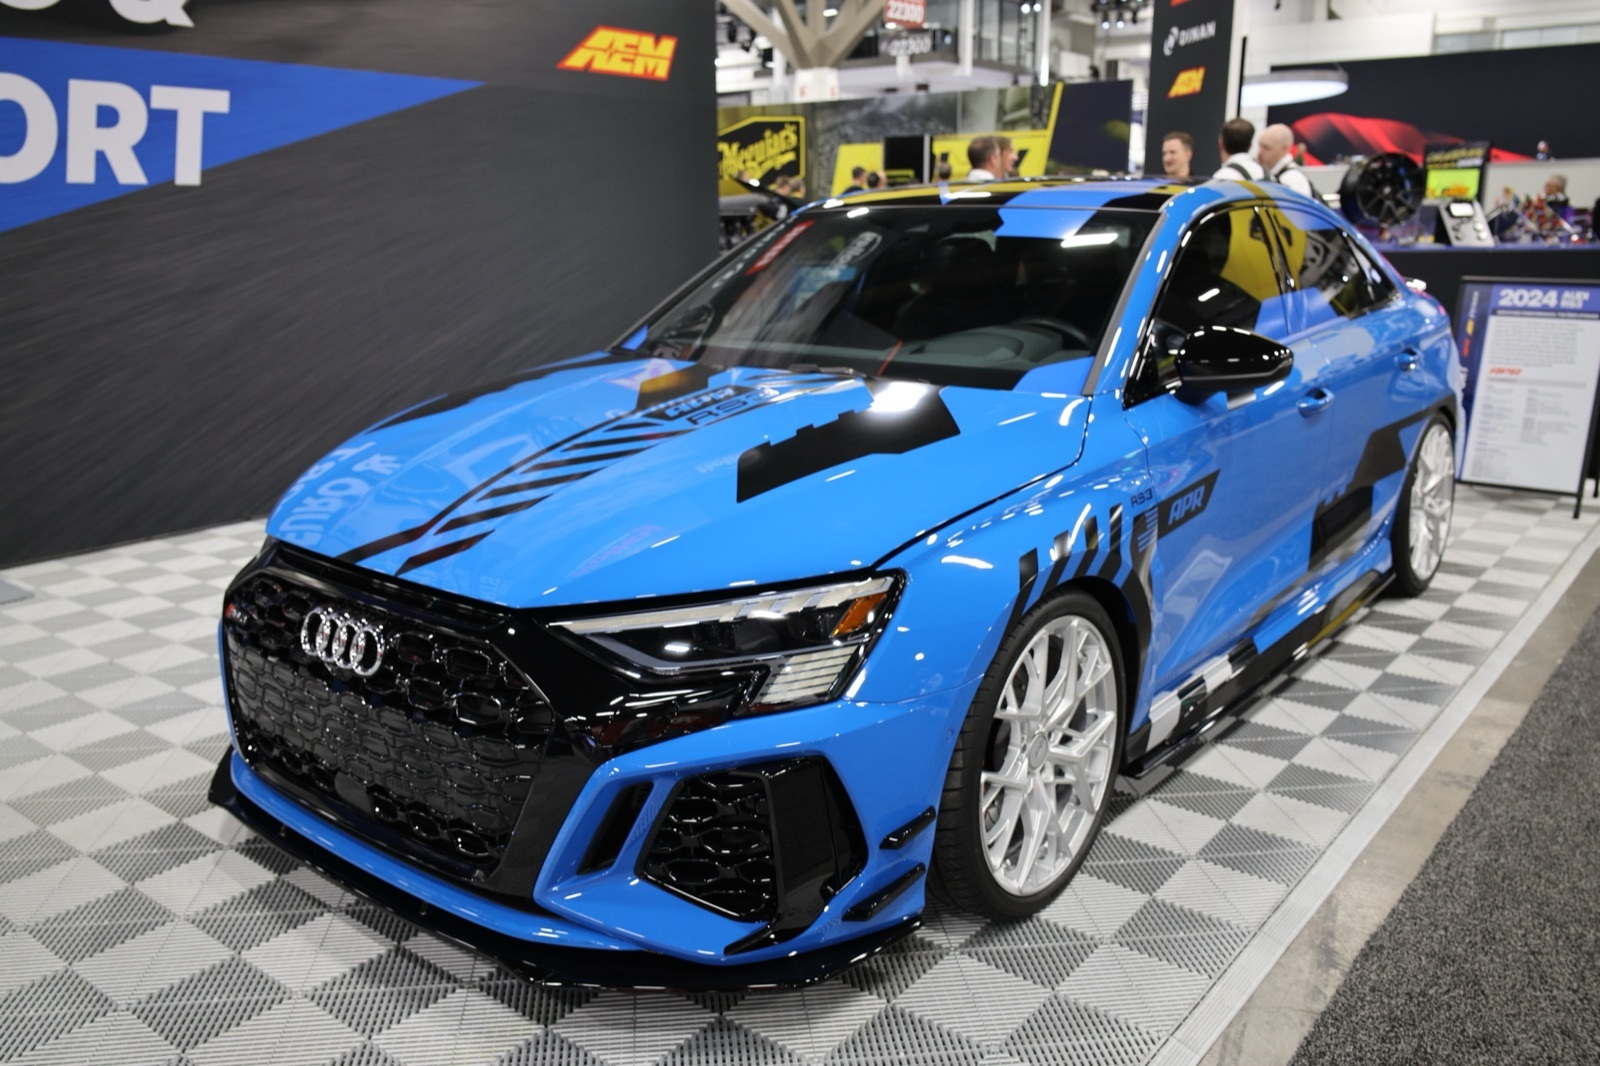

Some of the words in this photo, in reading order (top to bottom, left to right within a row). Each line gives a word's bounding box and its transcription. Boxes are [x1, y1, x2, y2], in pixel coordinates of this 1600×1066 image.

[556, 25, 678, 81] AEM
[0, 71, 230, 187] ORT
[1498, 288, 1559, 308] 2024
[1131, 487, 1153, 509] RS3
[1168, 484, 1206, 526] APR
